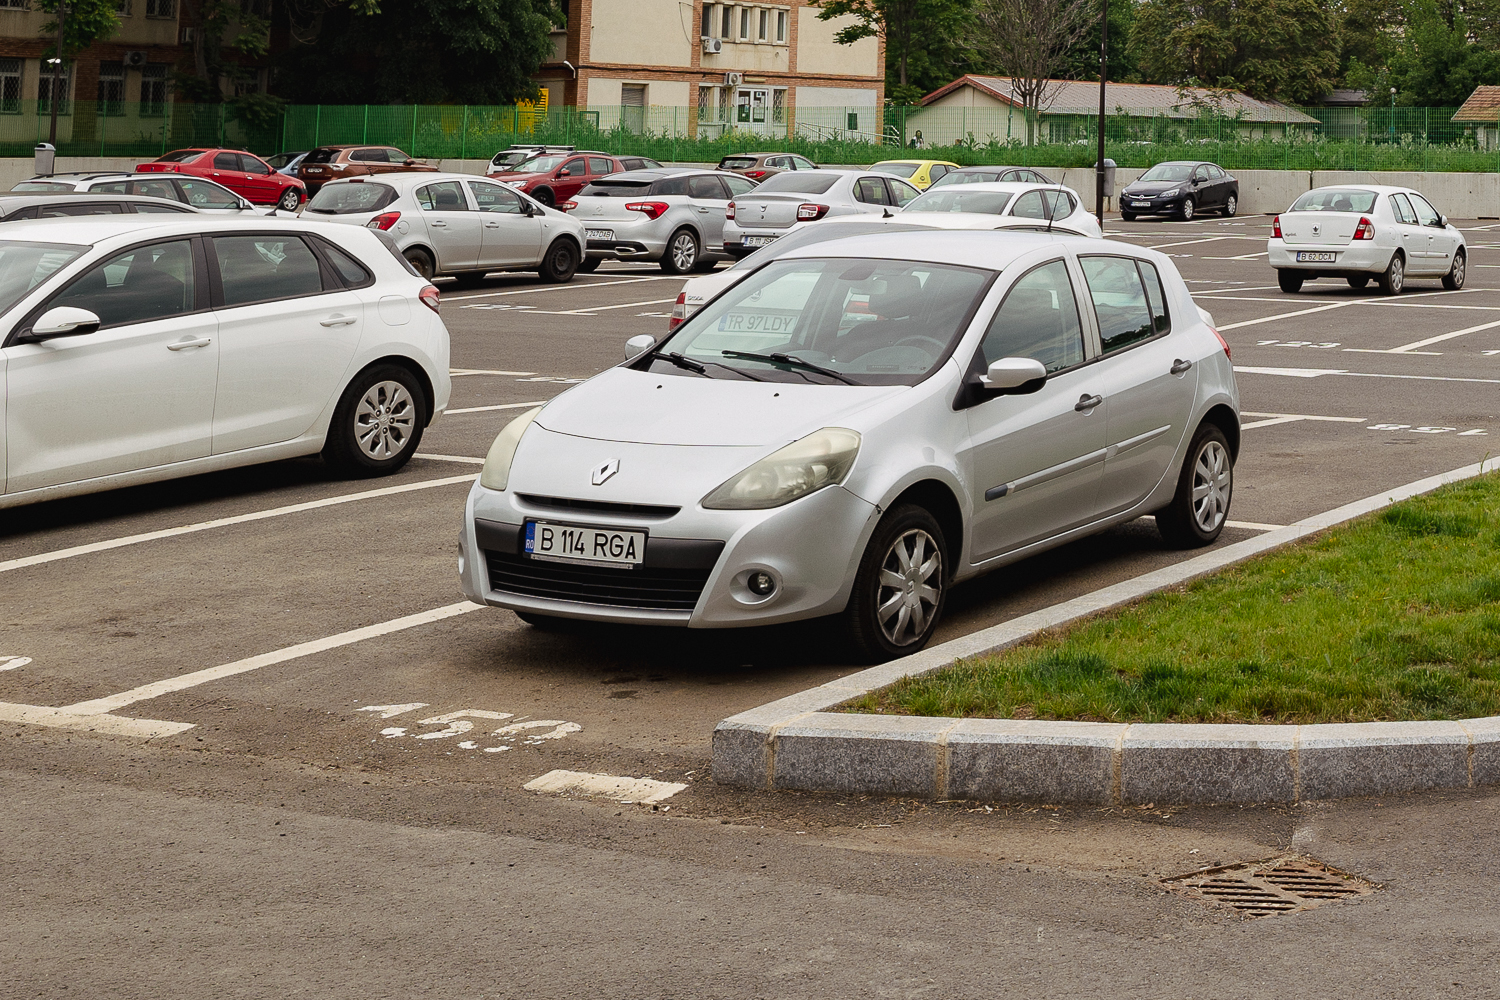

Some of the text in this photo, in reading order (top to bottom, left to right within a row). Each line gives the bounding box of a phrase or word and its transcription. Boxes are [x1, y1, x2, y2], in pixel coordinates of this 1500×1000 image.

[1318, 253, 1332, 261] DCA
[729, 315, 745, 330] TR
[1256, 339, 1341, 349] 123
[540, 527, 637, 560] B 114 RGA
